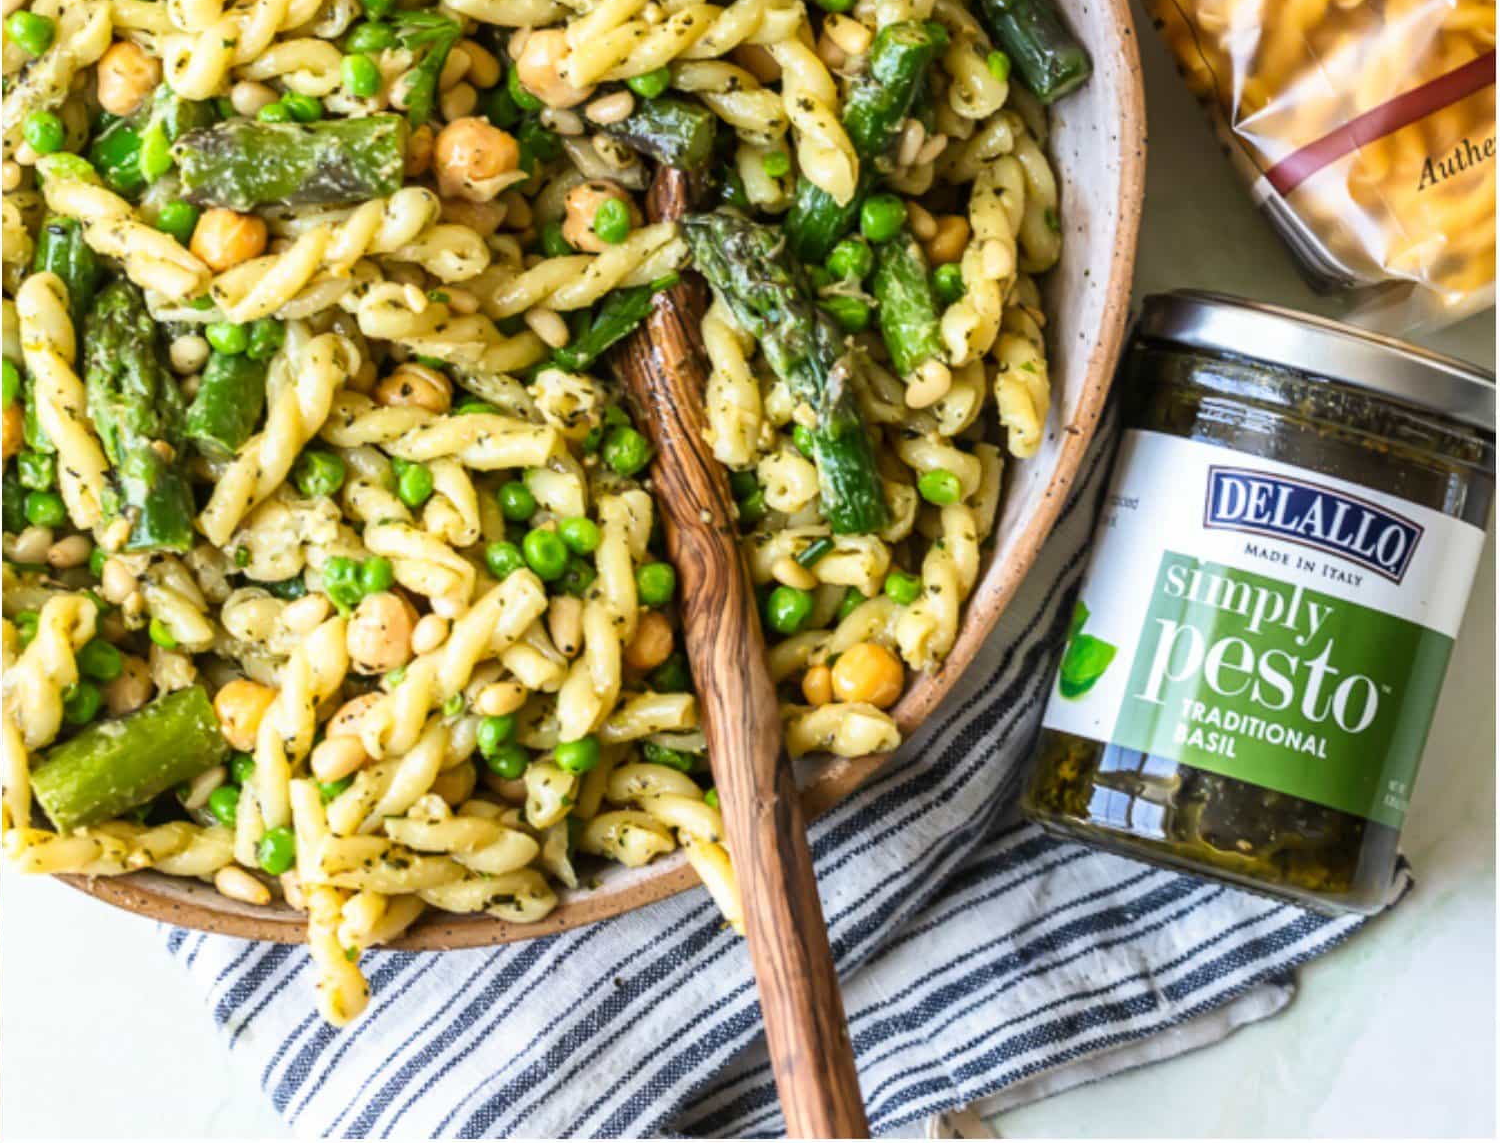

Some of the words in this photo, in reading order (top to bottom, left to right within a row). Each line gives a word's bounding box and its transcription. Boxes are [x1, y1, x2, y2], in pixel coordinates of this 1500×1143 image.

[1417, 137, 1496, 193] Authe
[1216, 477, 1408, 568] DELALLO
[1244, 542, 1290, 571] MADE
[1296, 556, 1316, 573] IN
[1322, 565, 1363, 587] ITALY
[1163, 563, 1334, 647] simply
[1133, 617, 1379, 735] pesto
[1173, 721, 1237, 758] BASIL
[1181, 698, 1328, 759] TRADITIONAL
